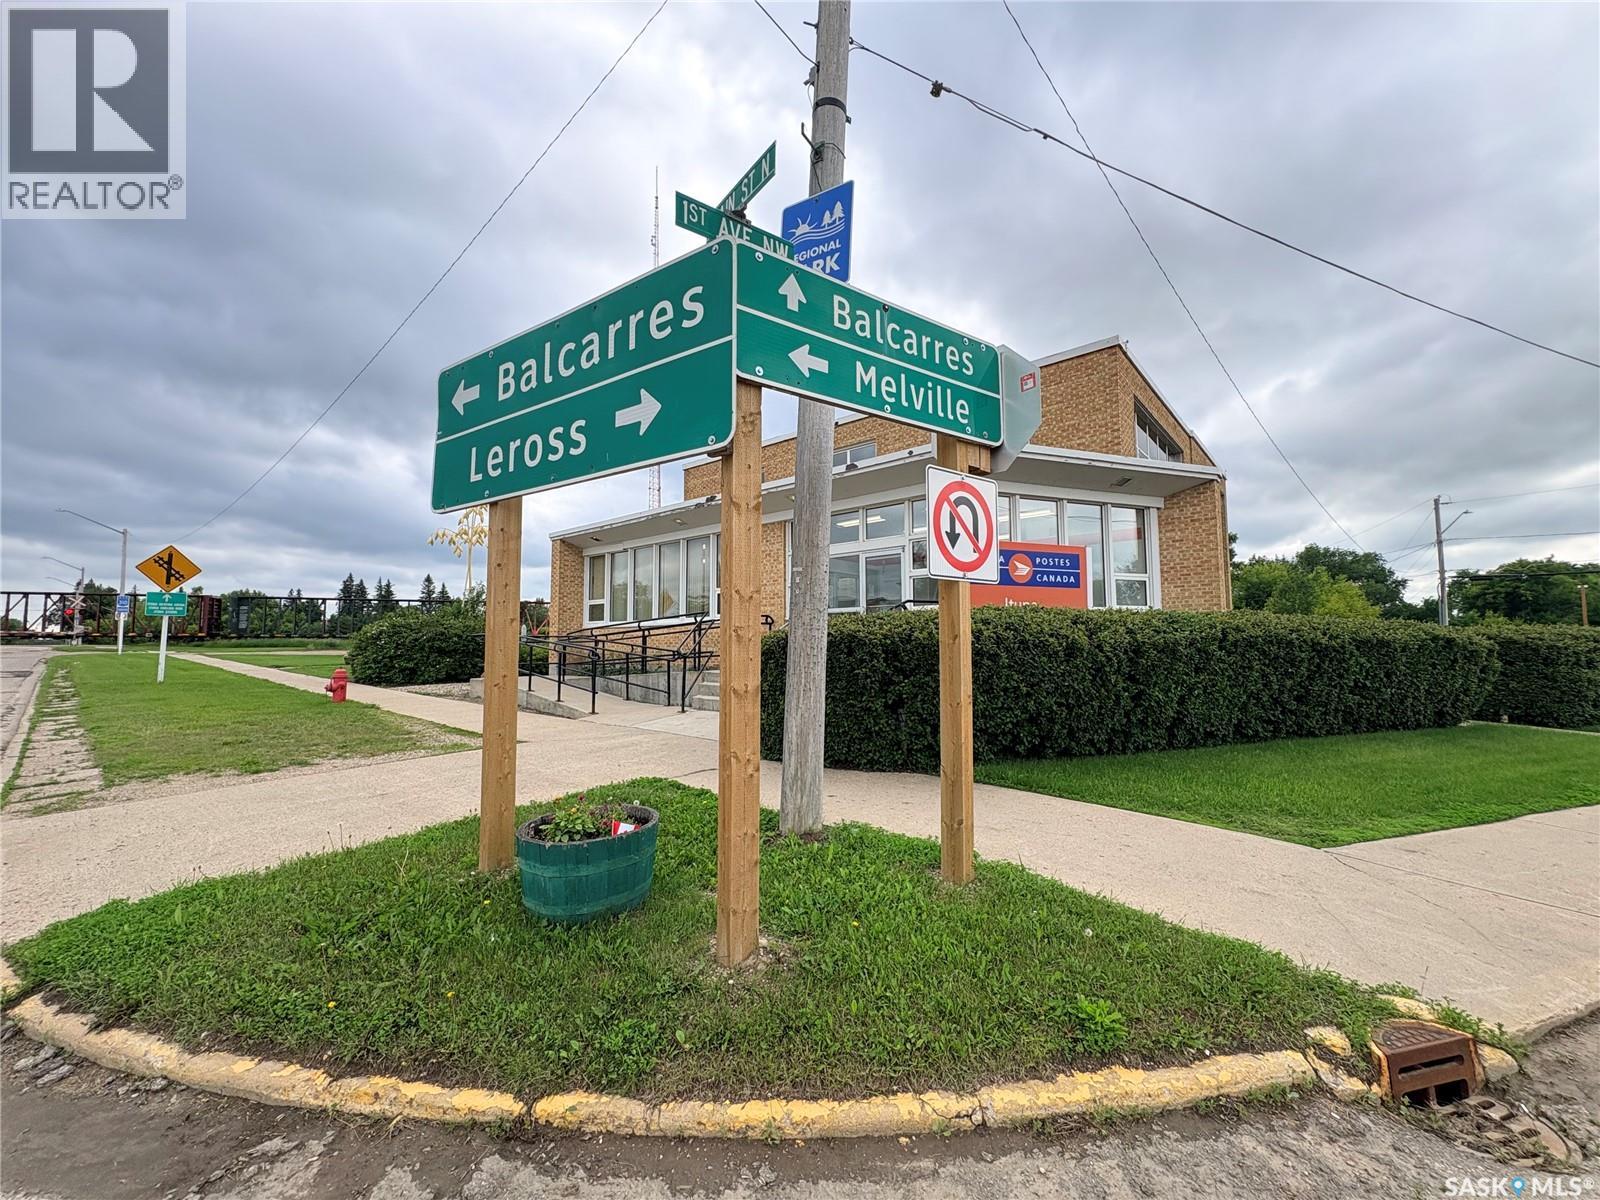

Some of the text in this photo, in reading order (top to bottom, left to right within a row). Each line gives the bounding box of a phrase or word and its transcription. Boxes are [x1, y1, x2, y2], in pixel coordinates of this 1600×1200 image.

[741, 169, 755, 204] ST
[761, 153, 770, 181] N
[682, 200, 788, 258] 1ST AVE NW
[793, 239, 842, 263] EGIONAL
[804, 252, 841, 274] RK
[498, 285, 705, 402] Balcarres
[832, 294, 974, 376] Balcarres
[855, 361, 970, 424] Melville
[469, 419, 587, 483] Leross
[1035, 557, 1071, 567] POSTES
[1036, 574, 1076, 584] CANADA
